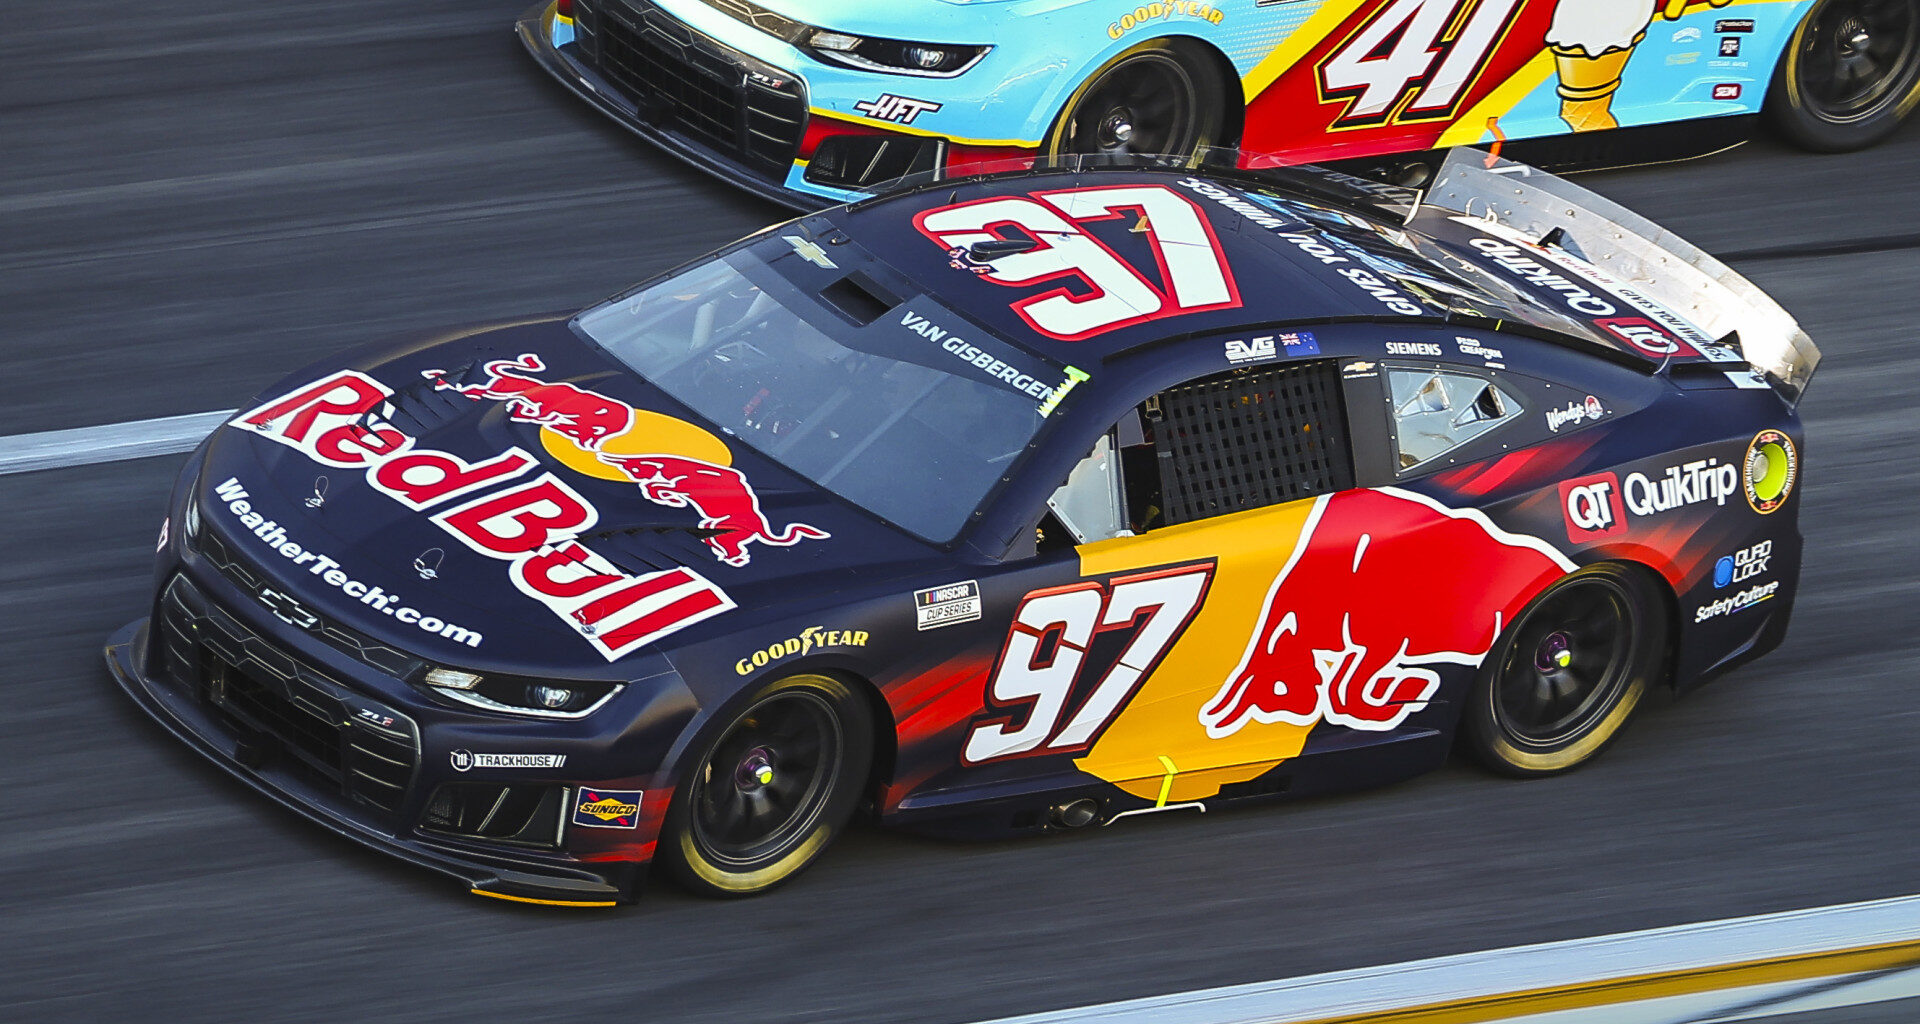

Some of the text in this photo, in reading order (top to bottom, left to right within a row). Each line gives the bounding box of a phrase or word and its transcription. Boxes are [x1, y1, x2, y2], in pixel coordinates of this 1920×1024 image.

[1107, 0, 1225, 40] GOODYEAR
[1316, 0, 1525, 130] 41
[854, 94, 942, 123] HFT
[1177, 177, 1289, 229] WINGS
[913, 185, 1243, 341] 97
[1278, 232, 1349, 265] YOU
[1336, 267, 1423, 316] GIVES
[1468, 238, 1680, 355] QT QuikTrip
[901, 311, 1054, 400] VAN GISBERGEN
[1225, 336, 1275, 358] SVG
[1385, 341, 1442, 356] SIEMENS
[1545, 401, 1585, 433] Wendy's
[1568, 458, 1738, 528] QT QuikTrip
[227, 368, 738, 664] Red Bull
[1732, 556, 1771, 582] LOCK
[1735, 540, 1772, 567] QUAD
[927, 602, 972, 620] CUP SERIES
[936, 585, 969, 602] NASCAR
[1695, 581, 1779, 623] SafetyCulture
[735, 626, 869, 676] GOODYEAR
[961, 563, 1215, 766] 97
[479, 755, 551, 767] TRACKHOUSE
[581, 803, 636, 815] SUNOCO
